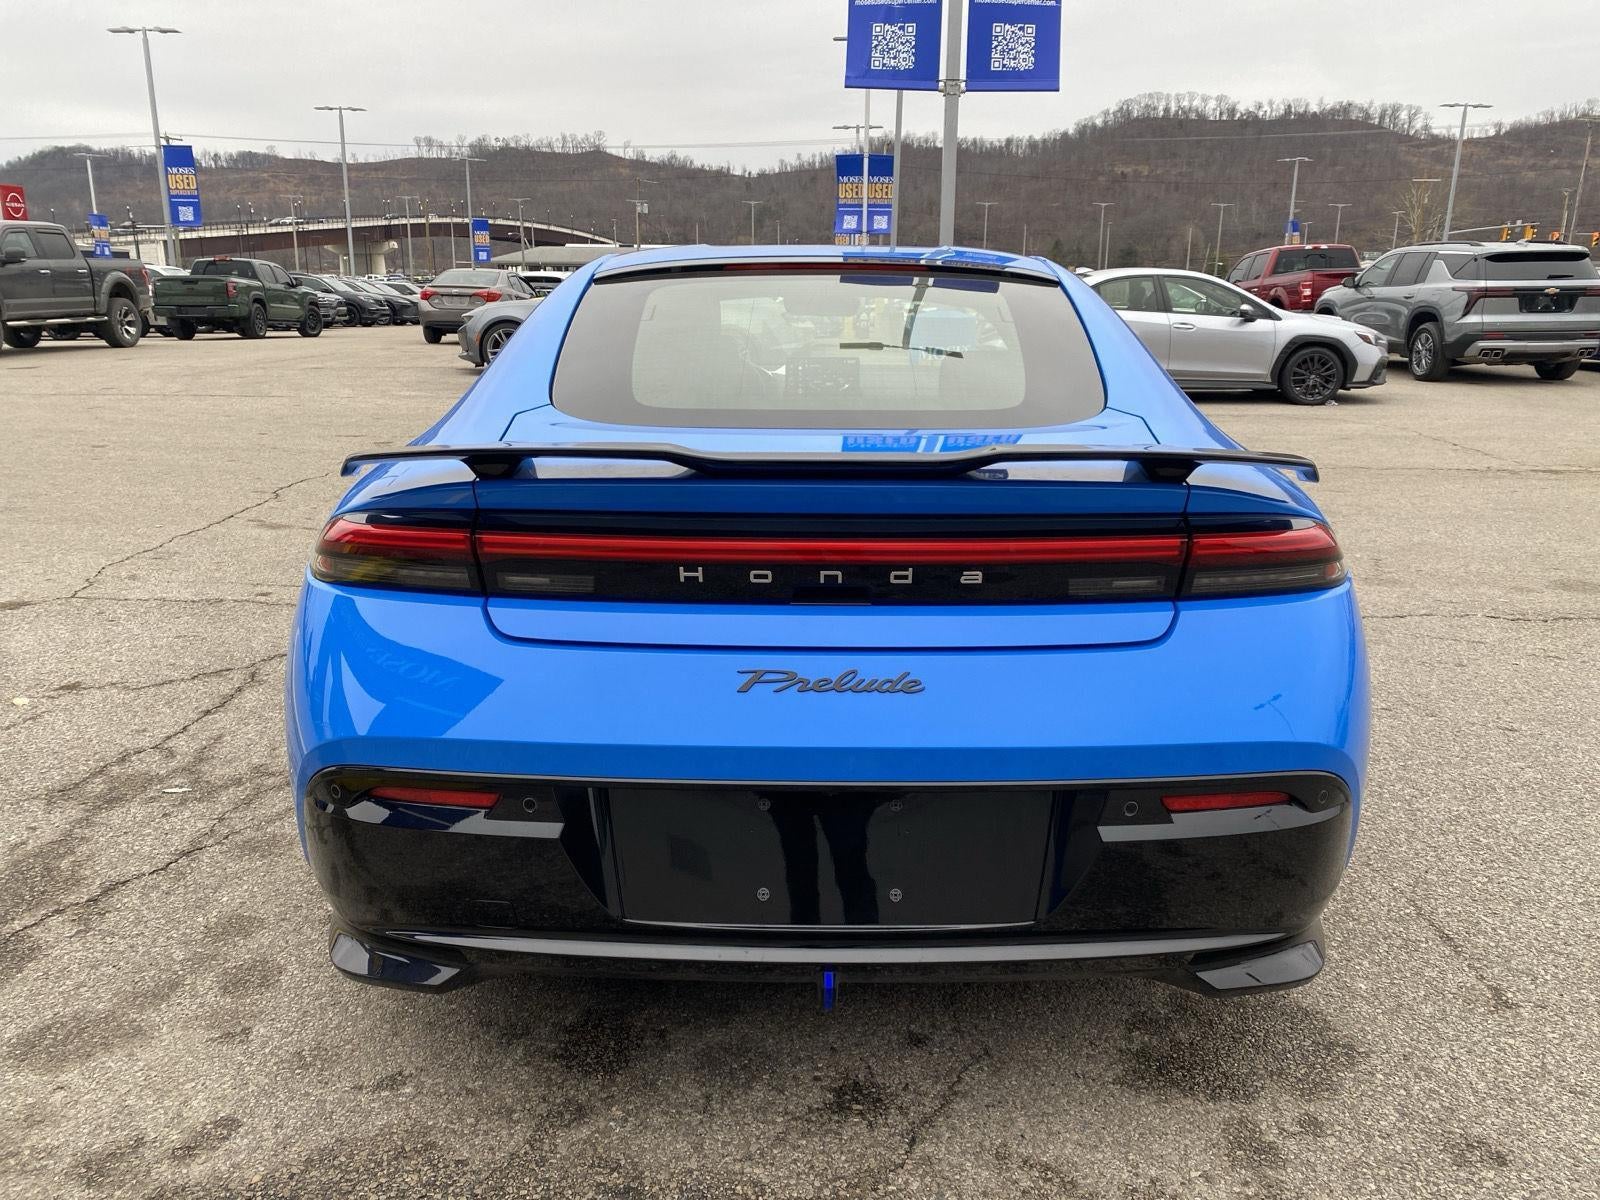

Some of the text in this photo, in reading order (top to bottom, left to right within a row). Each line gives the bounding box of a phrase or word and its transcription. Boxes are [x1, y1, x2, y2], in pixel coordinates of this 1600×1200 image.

[167, 167, 195, 175] MOSES
[168, 174, 197, 190] USED
[474, 234, 490, 243] USED
[678, 566, 983, 584] Honda
[736, 668, 926, 694] Prelude
